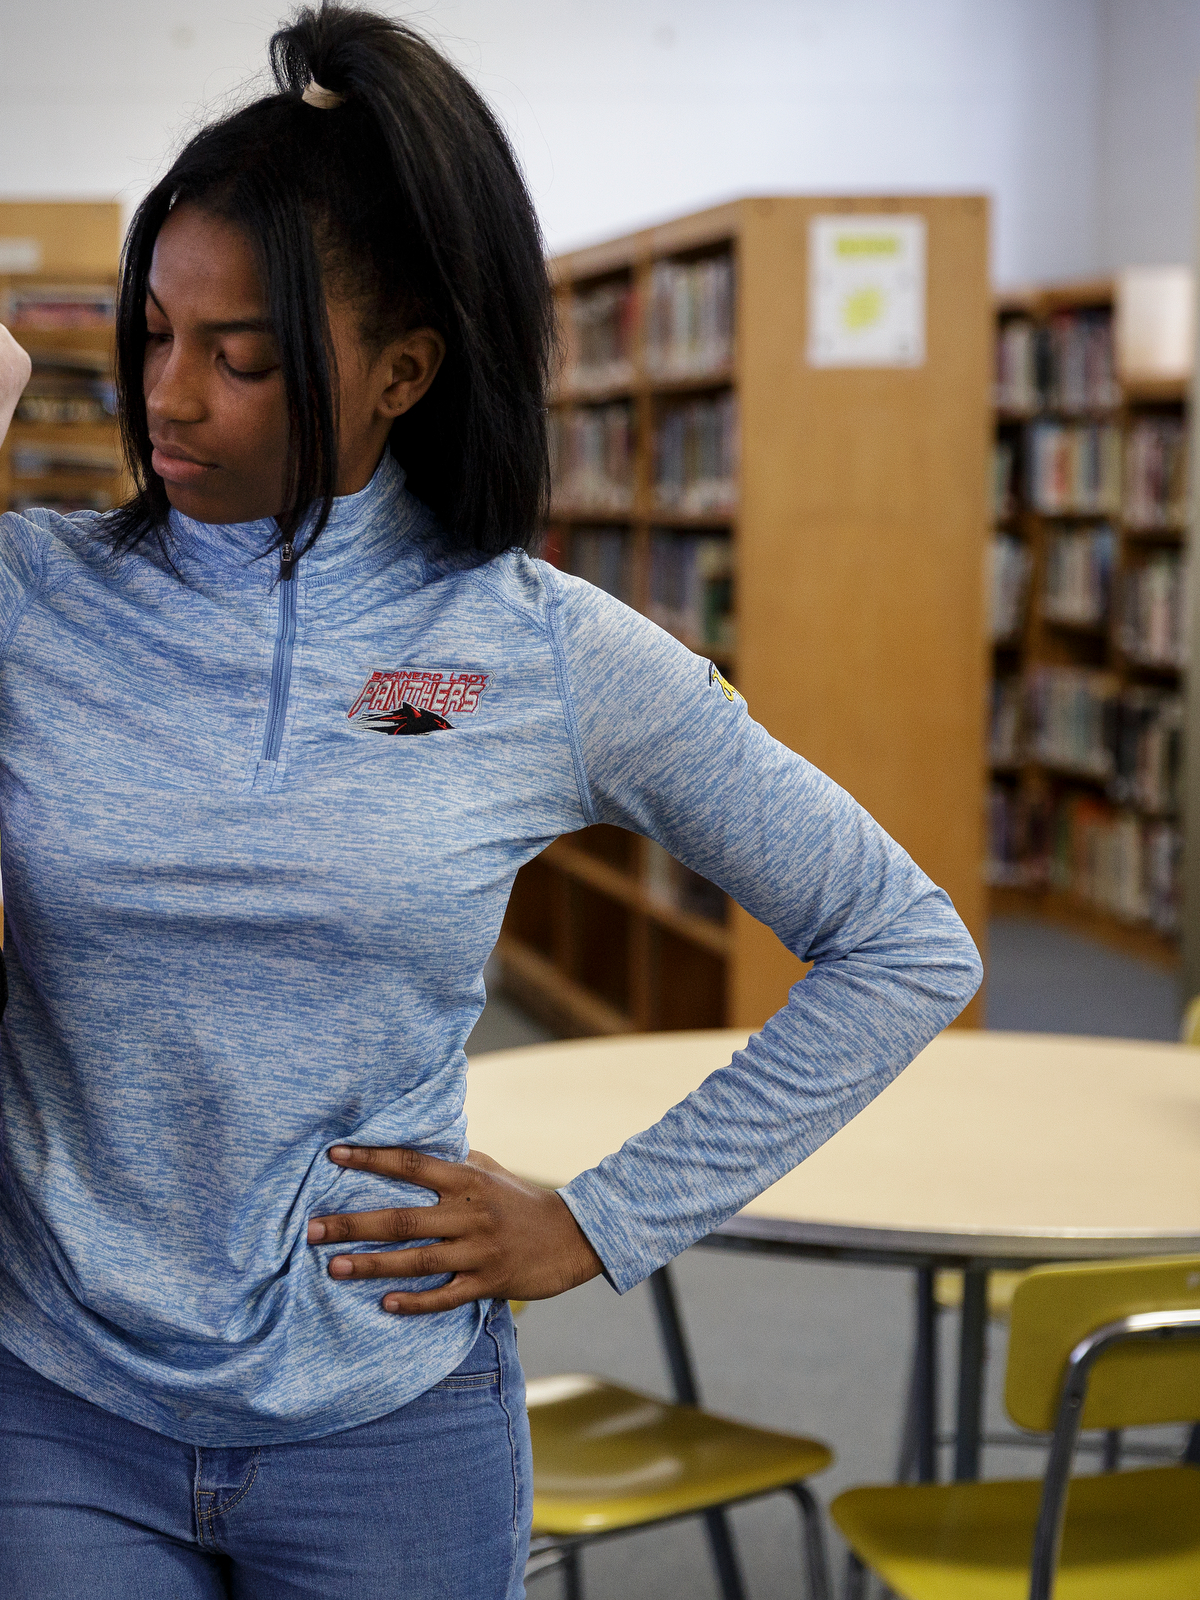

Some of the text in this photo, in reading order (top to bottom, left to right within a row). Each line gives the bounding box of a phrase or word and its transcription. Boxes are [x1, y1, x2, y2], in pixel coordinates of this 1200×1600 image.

[371, 671, 490, 684] BRAINERD LADY
[347, 680, 487, 718] PANTHERS
